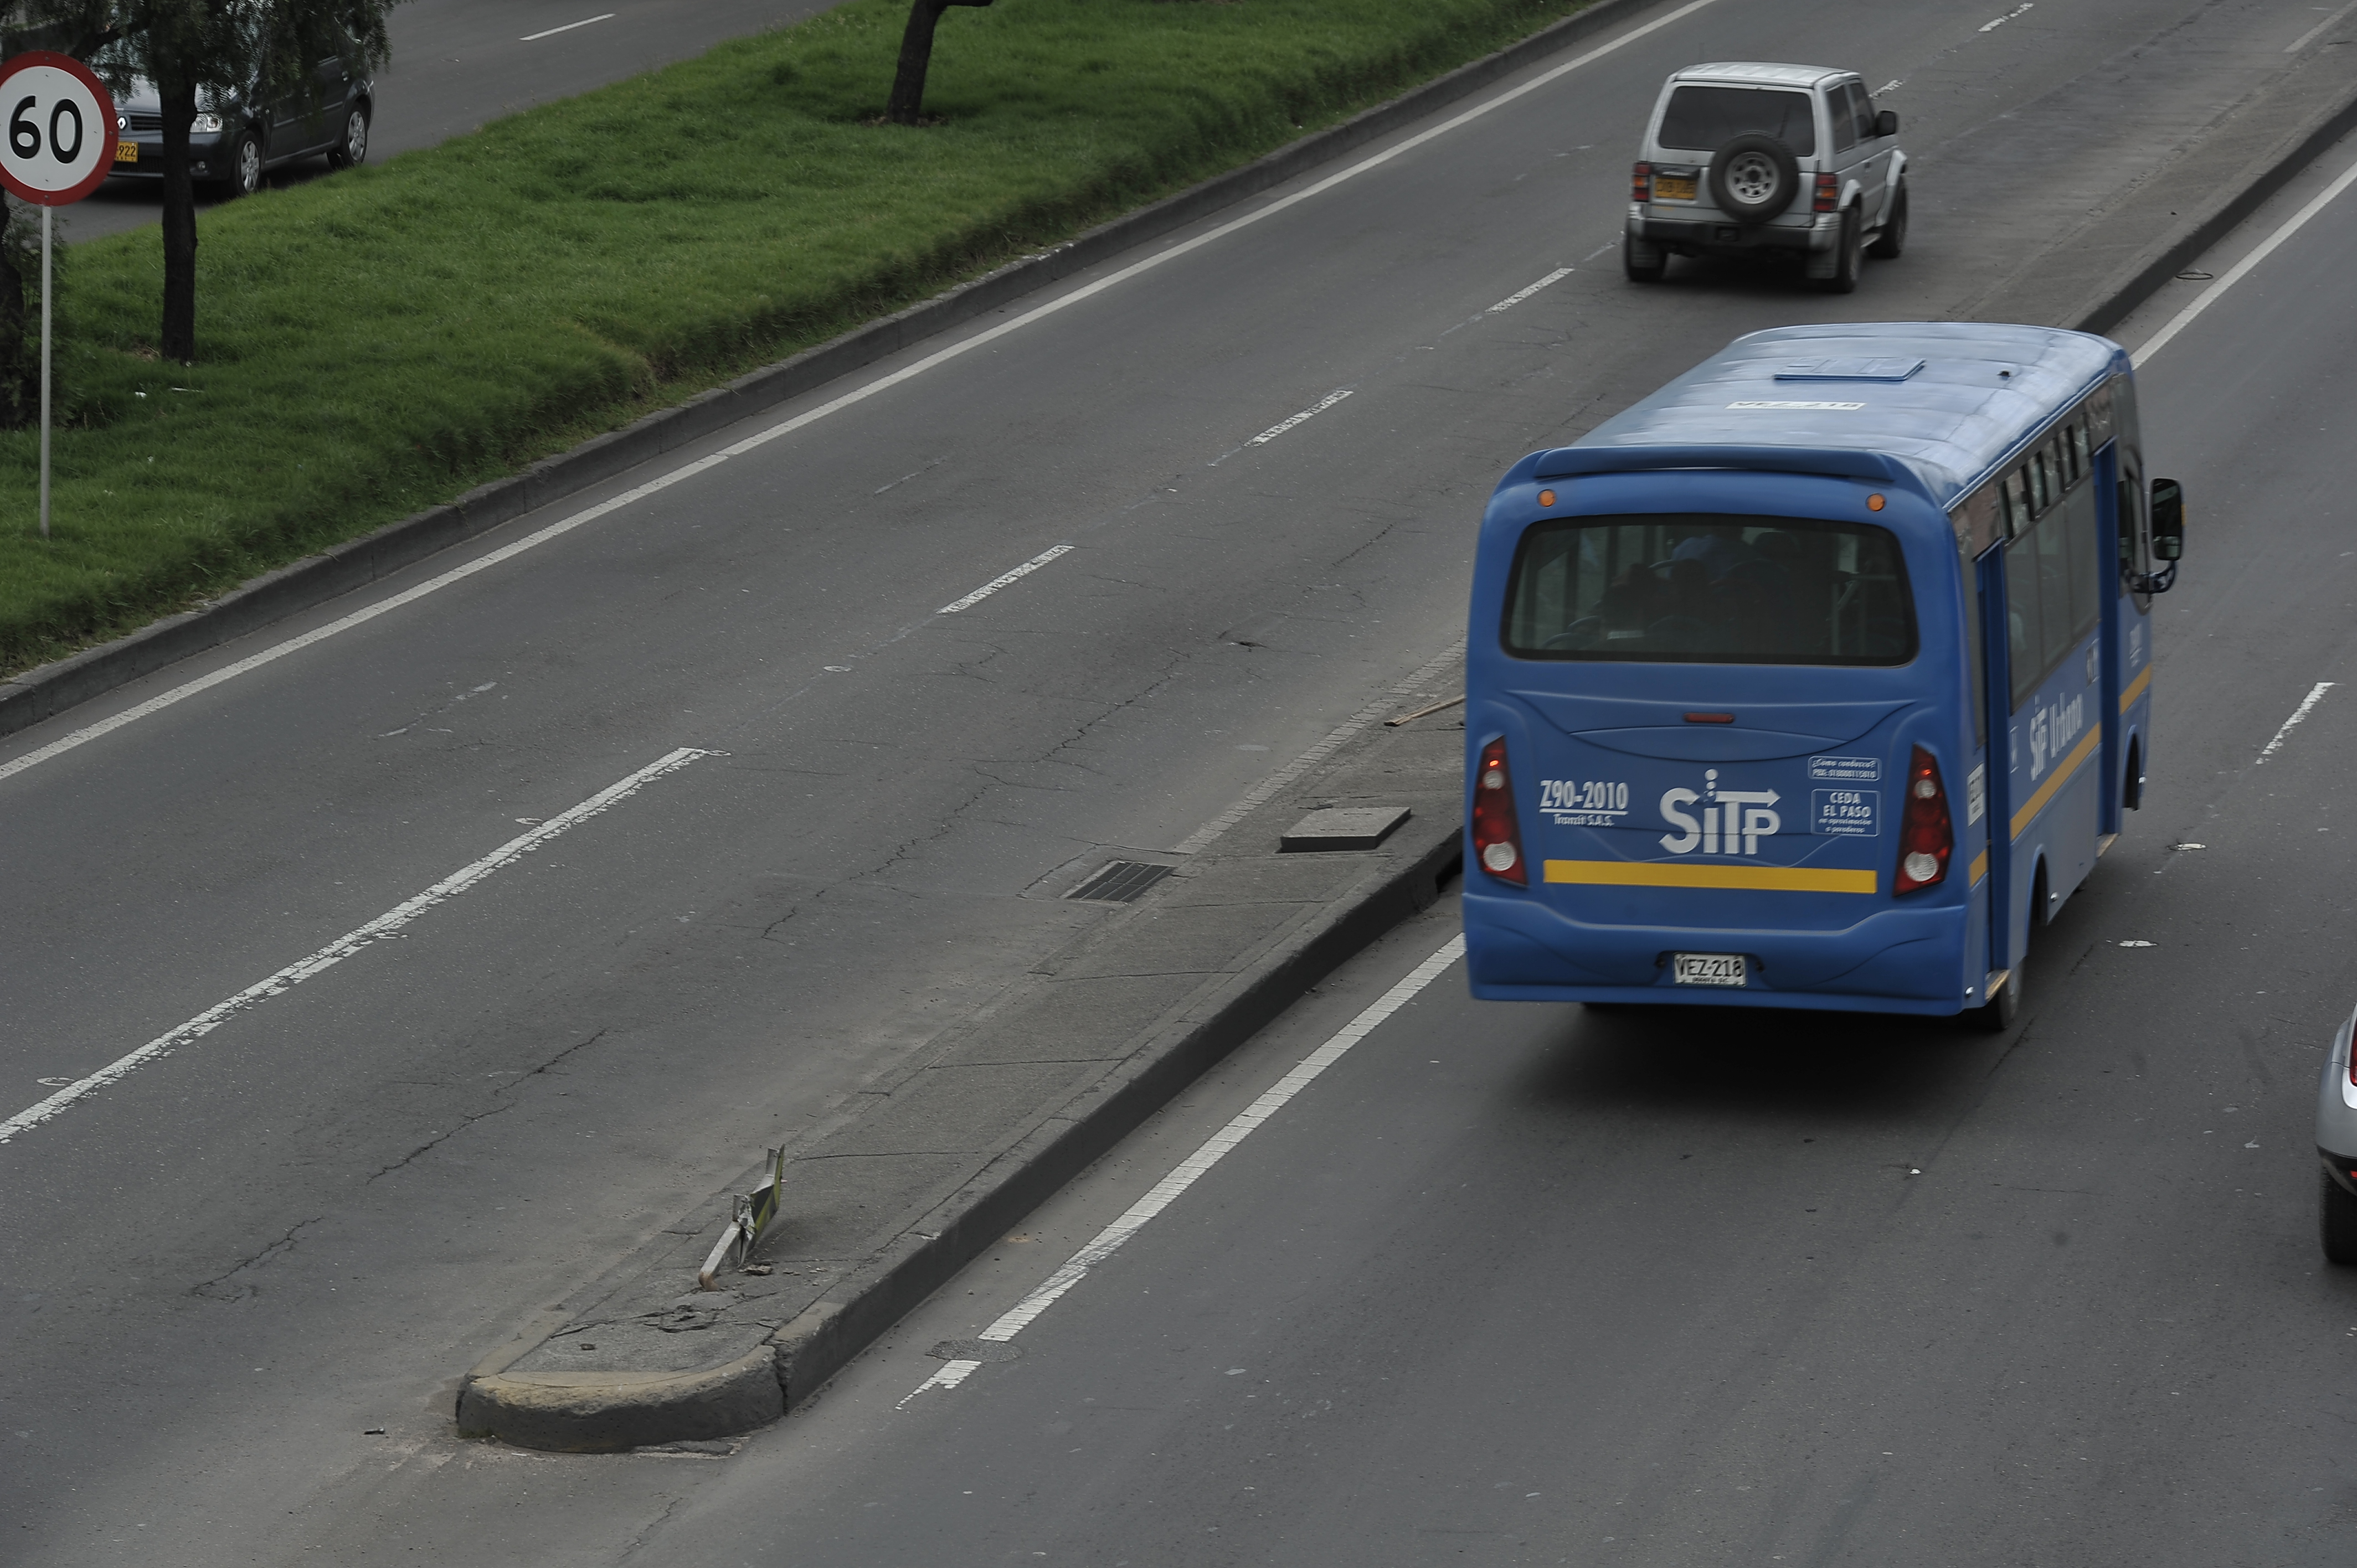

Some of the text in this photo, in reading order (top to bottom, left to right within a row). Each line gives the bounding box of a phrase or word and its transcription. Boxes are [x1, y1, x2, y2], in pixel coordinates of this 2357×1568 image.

[9, 95, 83, 163] 60
[1540, 780, 1629, 810] Z90-2010
[1829, 792, 1861, 804] CEDA
[1823, 804, 1872, 818] EL PASO
[1587, 814, 1615, 827] S.A.S.
